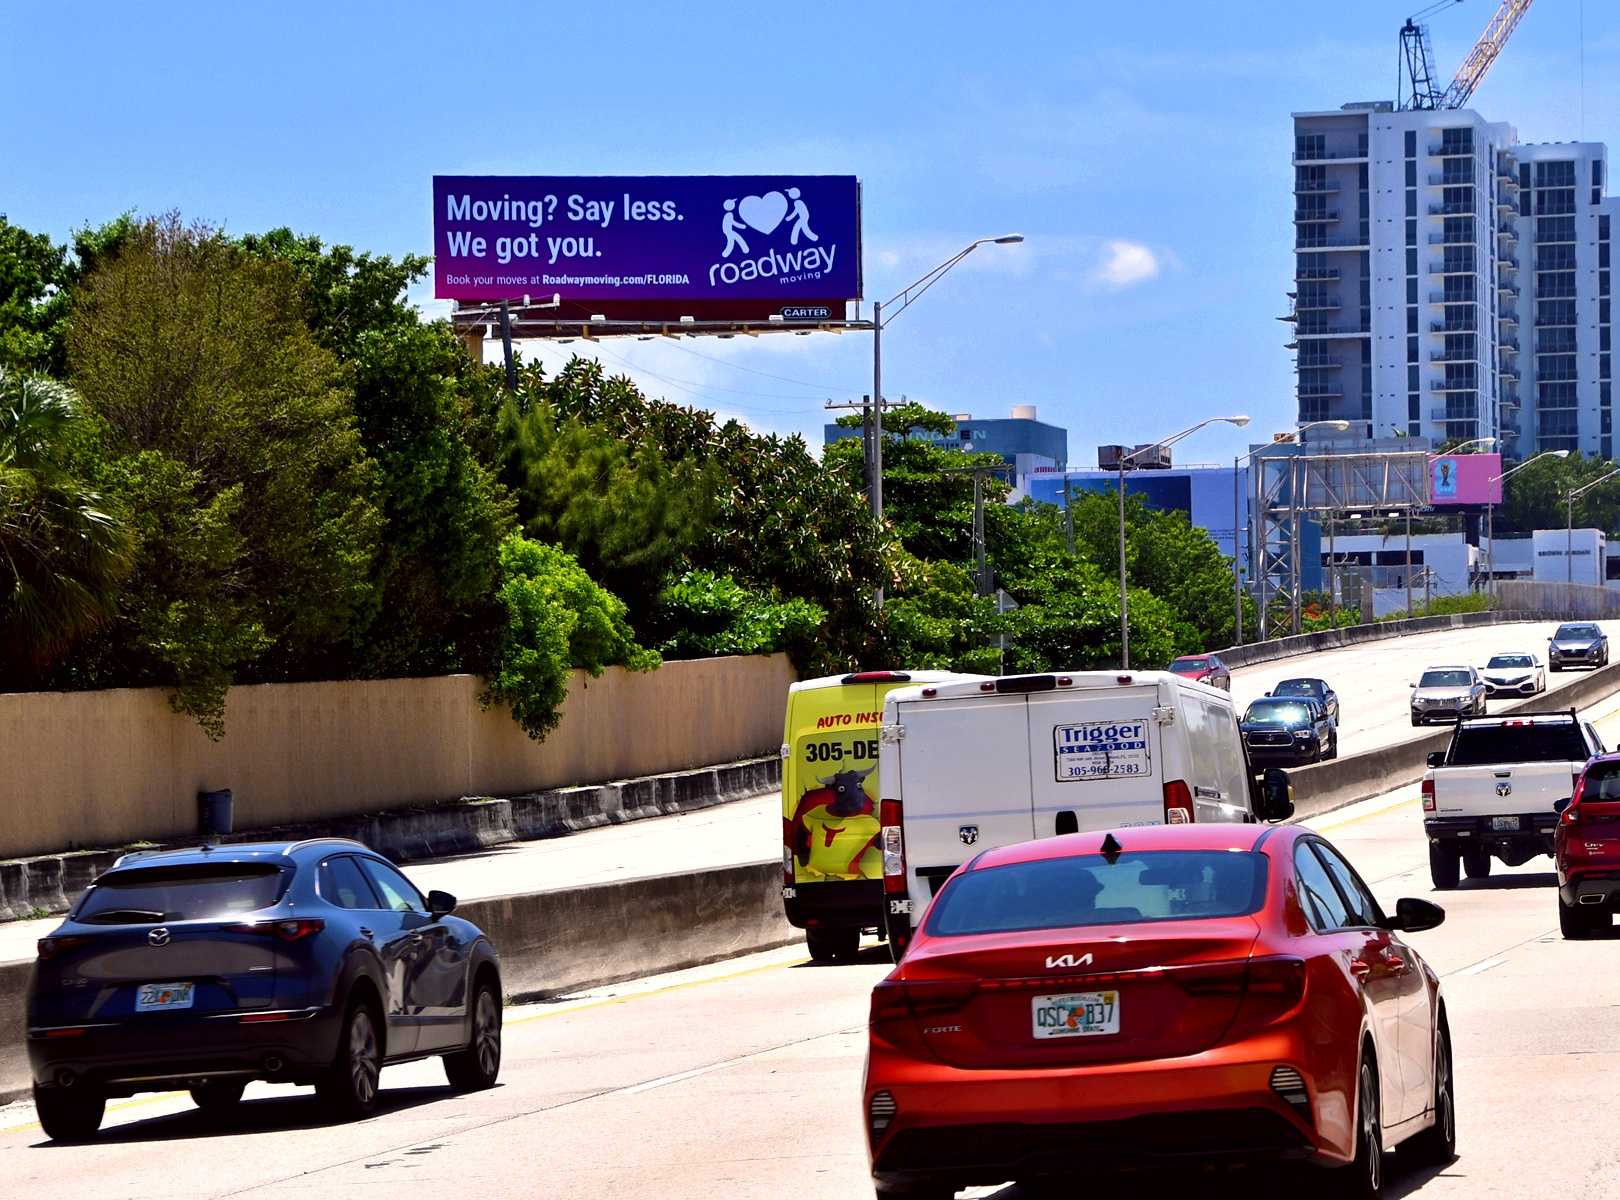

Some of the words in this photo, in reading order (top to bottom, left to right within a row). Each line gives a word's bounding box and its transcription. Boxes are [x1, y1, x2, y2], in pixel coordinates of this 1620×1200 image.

[447, 194, 558, 227] Moving?
[567, 194, 614, 227] Say
[624, 193, 684, 221] less.
[447, 231, 486, 257] We
[496, 233, 539, 264] got
[547, 237, 602, 264] you.
[709, 244, 836, 286] roadway
[446, 275, 470, 285] Book
[473, 277, 494, 287] your
[497, 276, 527, 285] moves
[530, 275, 541, 285] at
[542, 274, 690, 287] Roadwaymoving.com/FLORIDA
[779, 272, 821, 285] moving
[783, 308, 828, 317] CARTER
[817, 714, 852, 729] AUTO
[1061, 725, 1141, 743] Trigger
[805, 740, 880, 763] 305-DE
[1062, 742, 1142, 753] SEAFOOD
[1046, 953, 1093, 968] KIA
[1086, 1003, 1114, 1025] B37
